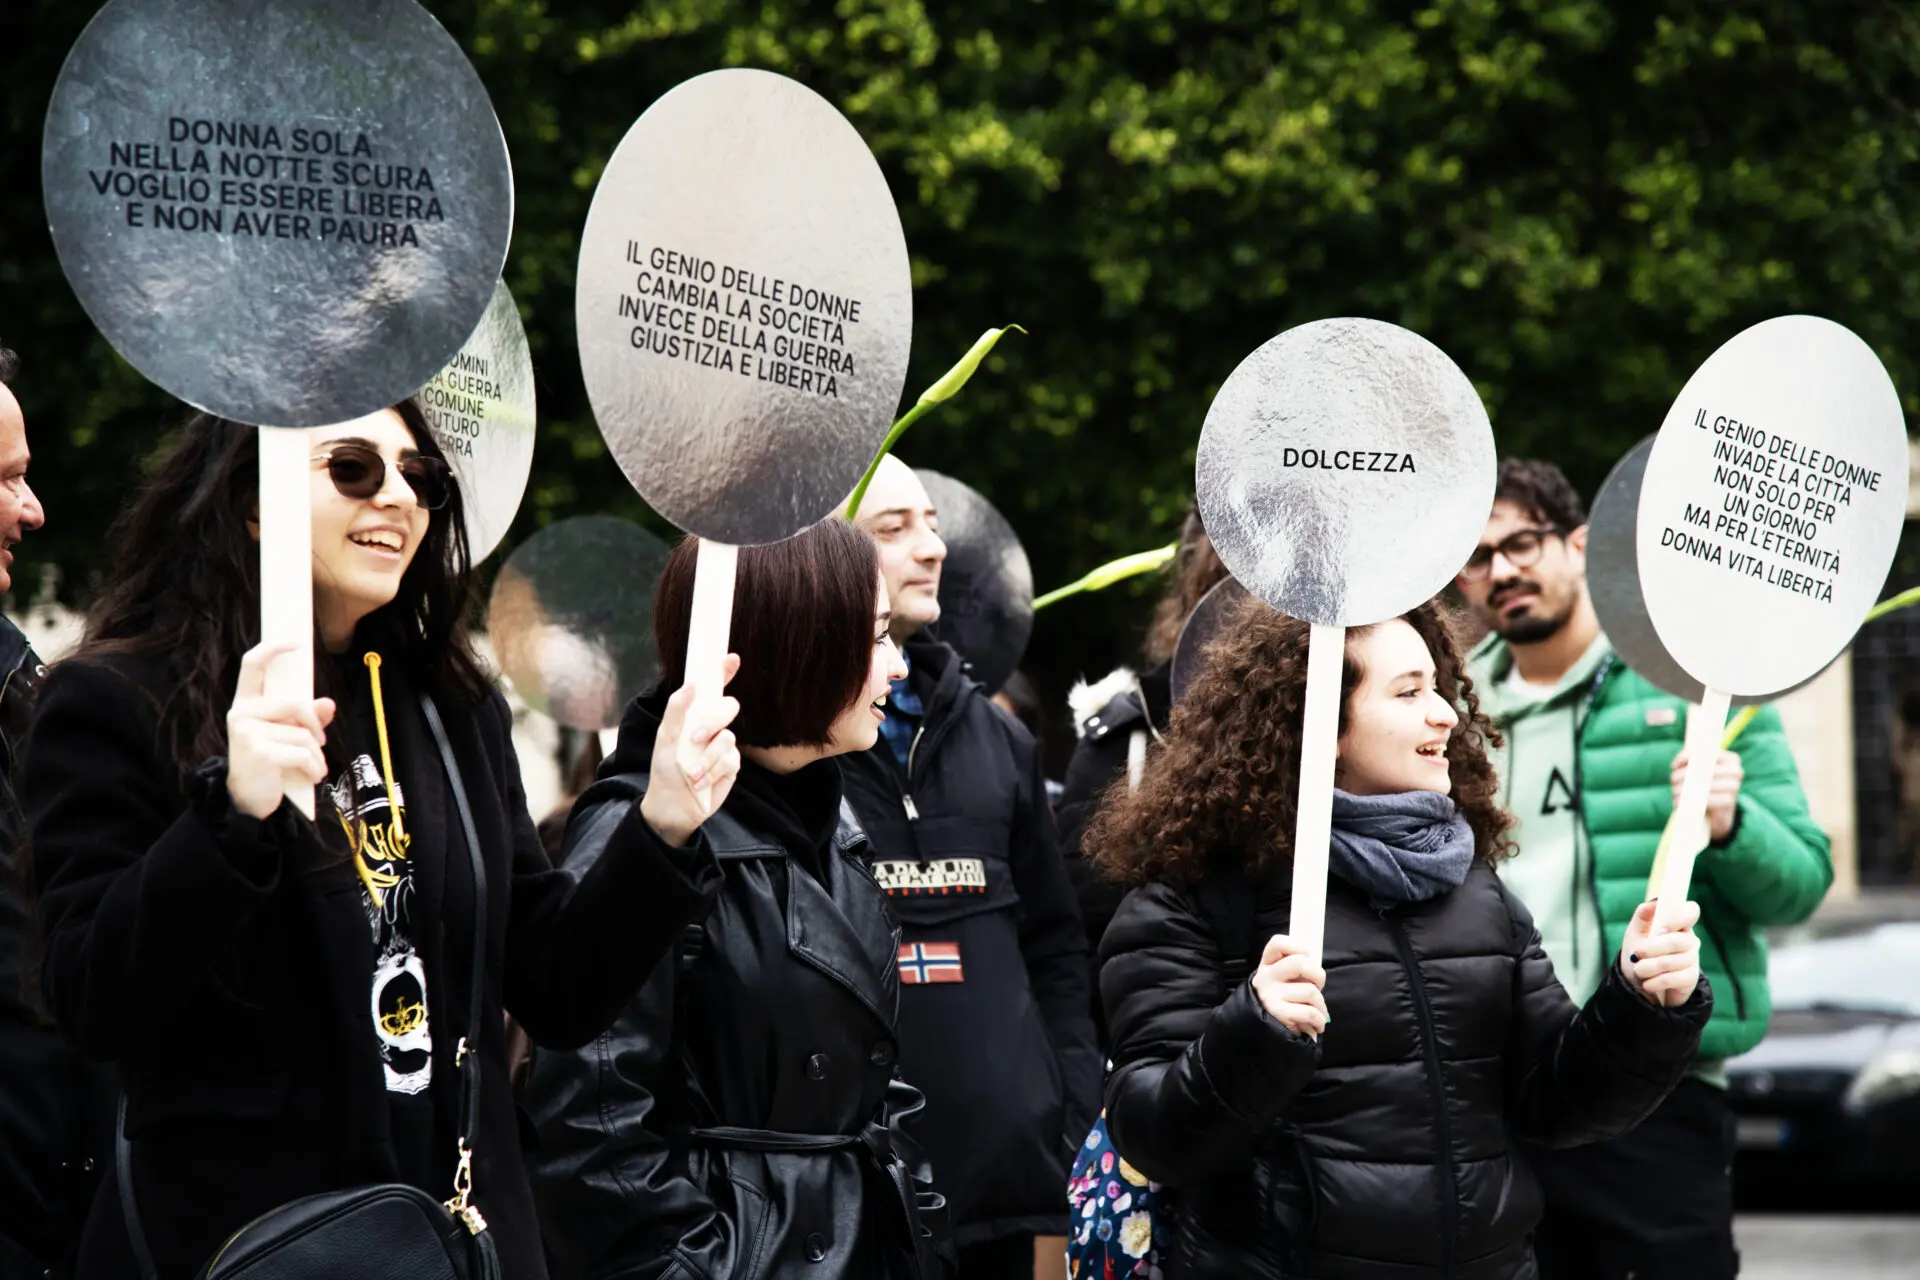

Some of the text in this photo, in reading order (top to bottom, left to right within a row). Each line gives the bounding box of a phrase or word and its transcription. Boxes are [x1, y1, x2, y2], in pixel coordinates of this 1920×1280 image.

[169, 116, 372, 158] DONNA SOLA
[110, 141, 435, 192] NELLA NOTTE SCURA
[88, 169, 444, 222] VOGLIO ESSERE LIBERA
[127, 202, 419, 248] E NON AVER PAURA
[626, 239, 861, 323] IL GENIO DELLE DONNE
[637, 271, 844, 346] CAMBIA LA SOCIETÀ
[618, 293, 854, 377] INVECE DELLA GUERRA
[448, 371, 502, 402] GUERRA
[450, 352, 489, 376] OMINI
[630, 325, 837, 398] GIUSTIZIA E LIBERTÀ
[424, 387, 485, 419] COMUNE
[424, 408, 480, 438] FUTURO
[434, 430, 473, 457] ERRA
[1283, 447, 1416, 473] DOLCEZZA
[1694, 408, 1882, 492] IL GENIO DELLE DONNE
[1713, 440, 1851, 507] INVADE LA CITTÀ
[1713, 465, 1836, 524] NON SOLO PER
[1683, 503, 1841, 575] MA PER L'ETERNITÀ
[1723, 492, 1817, 541] UN GIORNO
[1660, 527, 1834, 604] DONNA VITA LIBERTÀ
[873, 859, 984, 886] APAPIJRI
